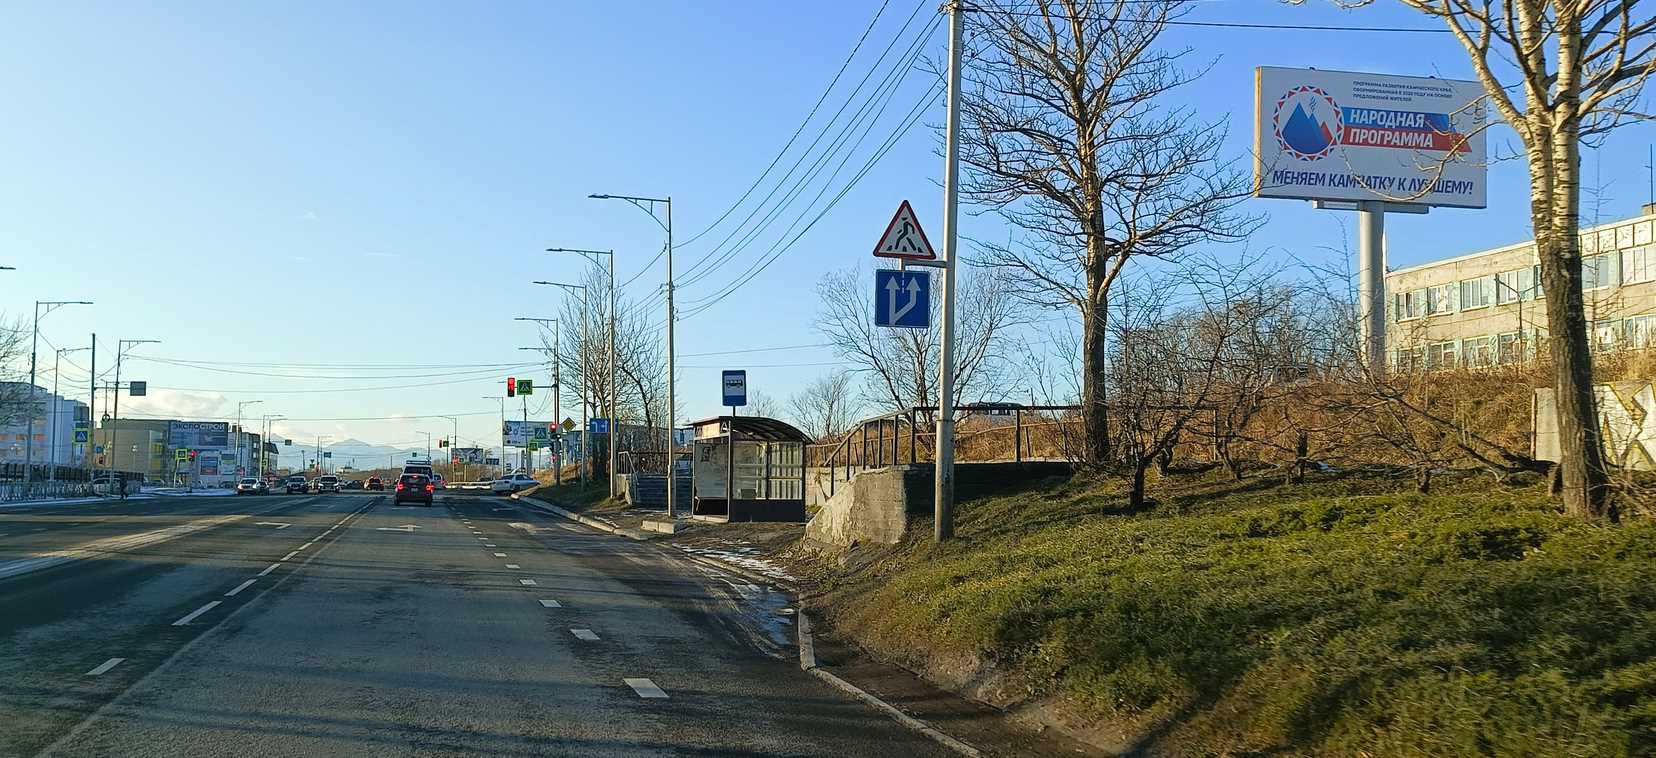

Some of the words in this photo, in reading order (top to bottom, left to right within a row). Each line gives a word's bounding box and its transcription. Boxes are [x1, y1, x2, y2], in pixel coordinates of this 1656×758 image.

[1350, 109, 1425, 128] НАРОДНАЯ
[1349, 128, 1433, 148] ПРОГРАММА
[1272, 170, 1326, 186] МЕНЯЕМ
[1328, 173, 1395, 190] КАМЧАТКУ
[1398, 177, 1407, 191] К
